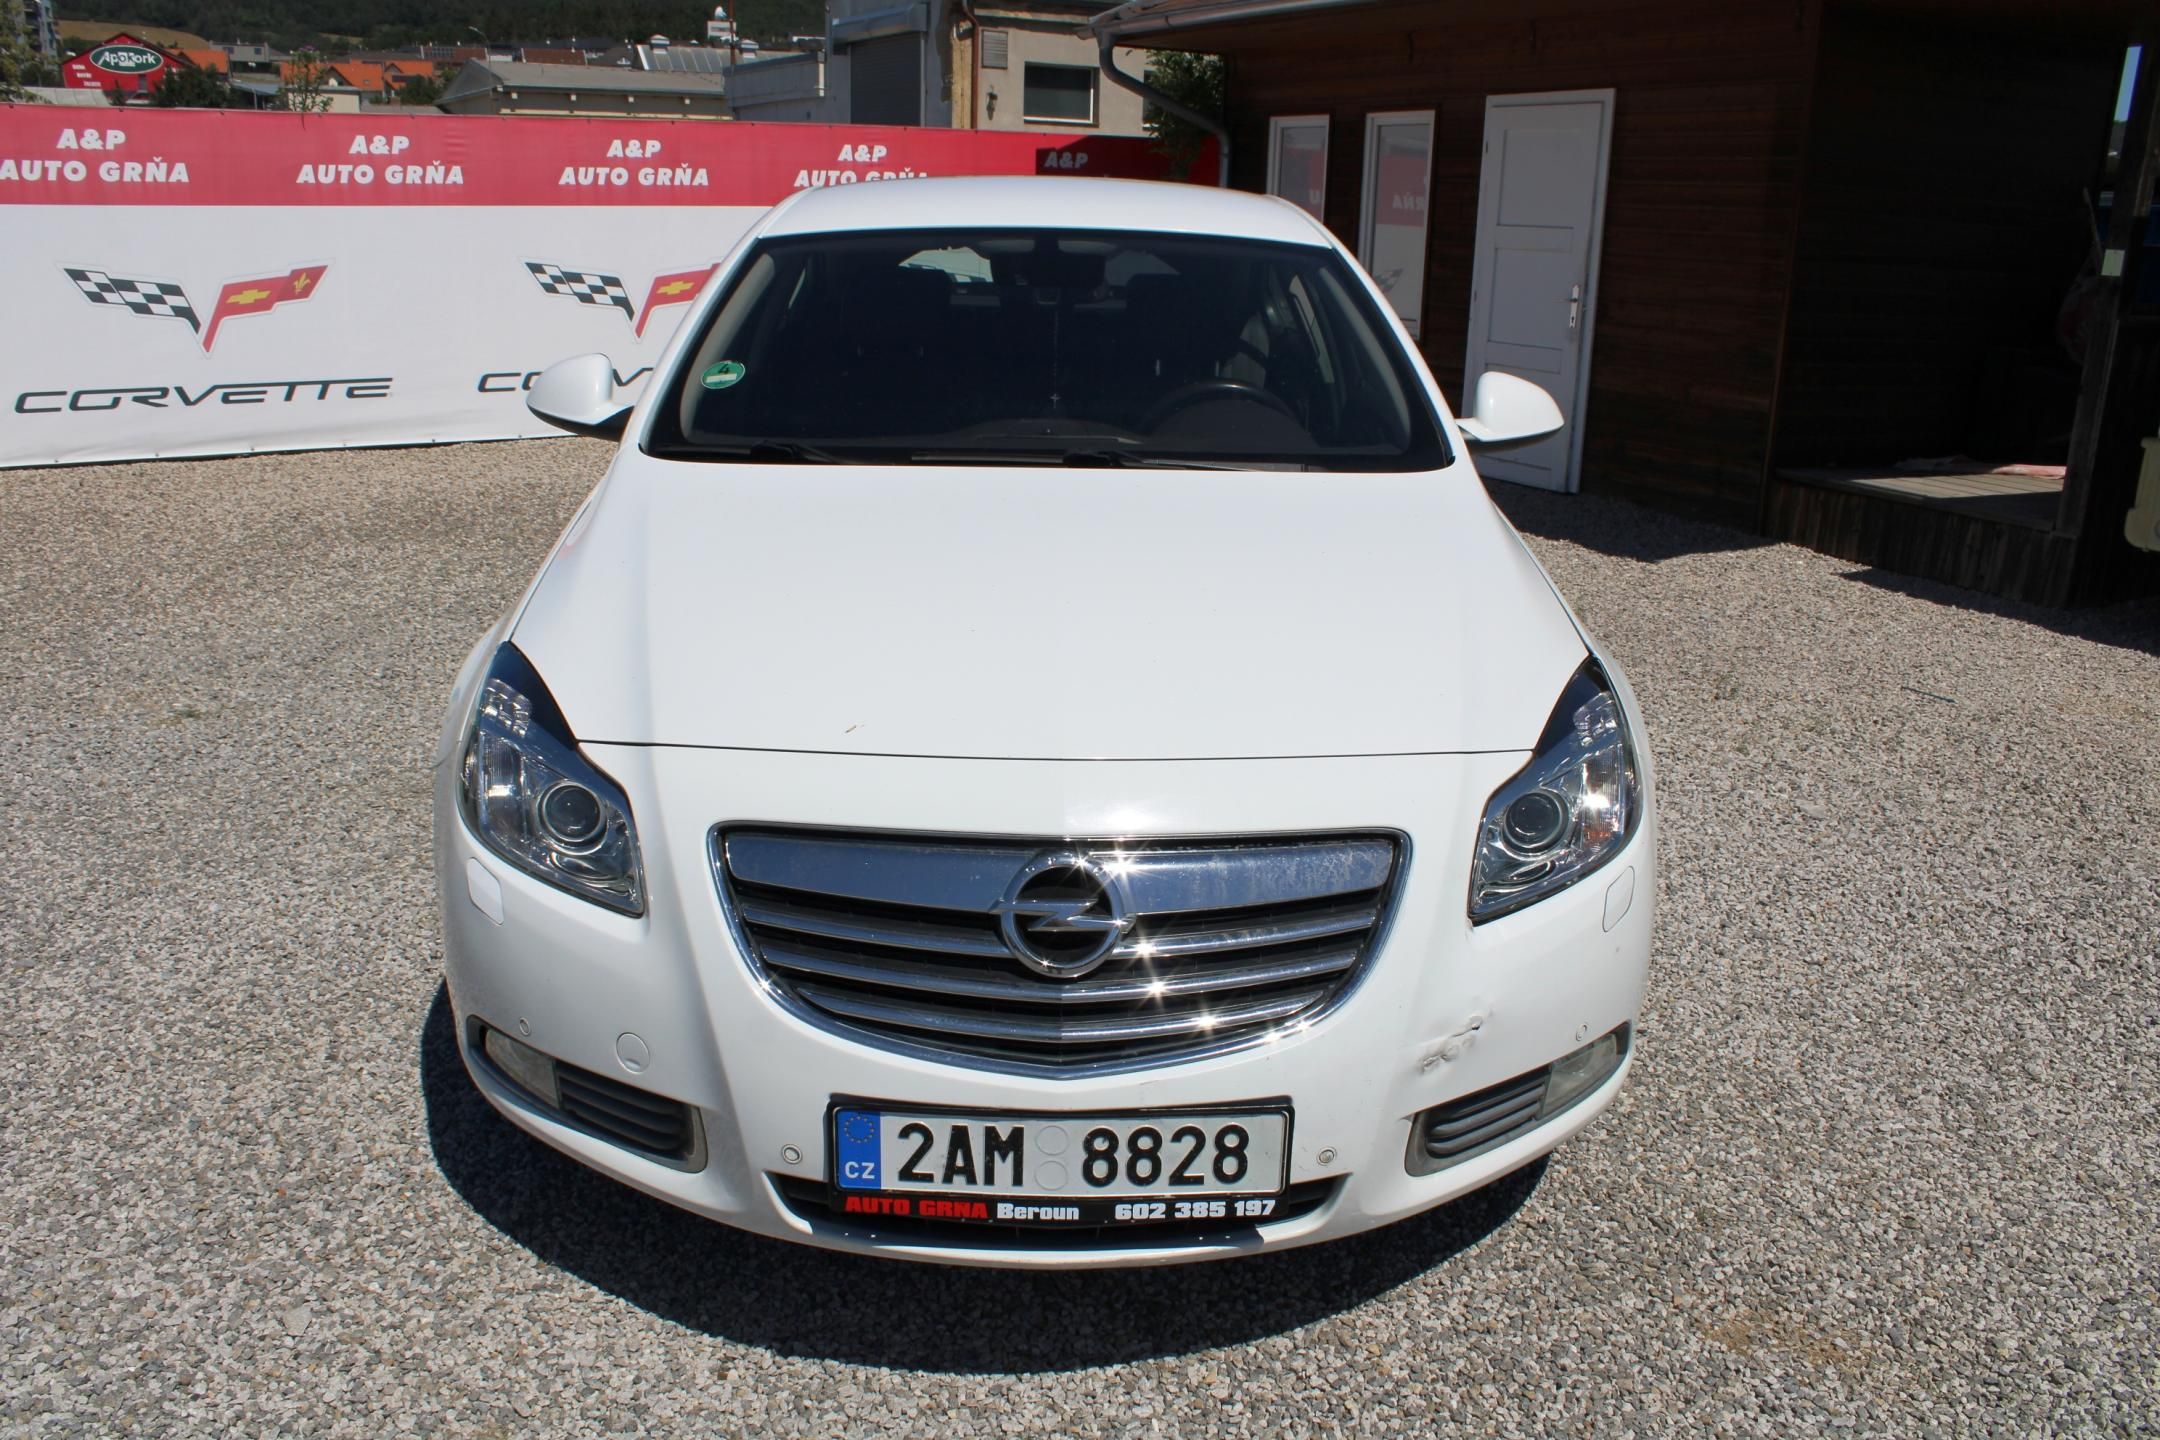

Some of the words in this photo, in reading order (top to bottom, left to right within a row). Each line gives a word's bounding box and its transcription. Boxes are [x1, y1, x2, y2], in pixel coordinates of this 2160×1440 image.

[56, 128, 126, 150] A&P
[348, 135, 410, 154] A&P
[606, 139, 662, 158] A&P
[838, 144, 888, 162] A&P
[1044, 151, 1088, 168] A&P
[0, 159, 87, 181] AUTO
[99, 156, 190, 183] GRŇA
[296, 164, 374, 184] AUTO
[384, 160, 464, 184] GRŇA
[558, 166, 629, 186] AUTO
[638, 162, 709, 186] GRŇA
[793, 169, 857, 188] AUTO
[14, 377, 393, 413] CORVETTE
[898, 1122, 1025, 1187] 2AM
[1082, 1123, 1250, 1188] 8828
[845, 1161, 875, 1179] CZ
[845, 1196, 911, 1215] AUTO
[919, 1201, 988, 1219] GRNA
[997, 1203, 1079, 1220] Beroun
[1115, 1203, 1166, 1220] 602
[1174, 1201, 1226, 1219] 385
[1234, 1200, 1276, 1217] 197
